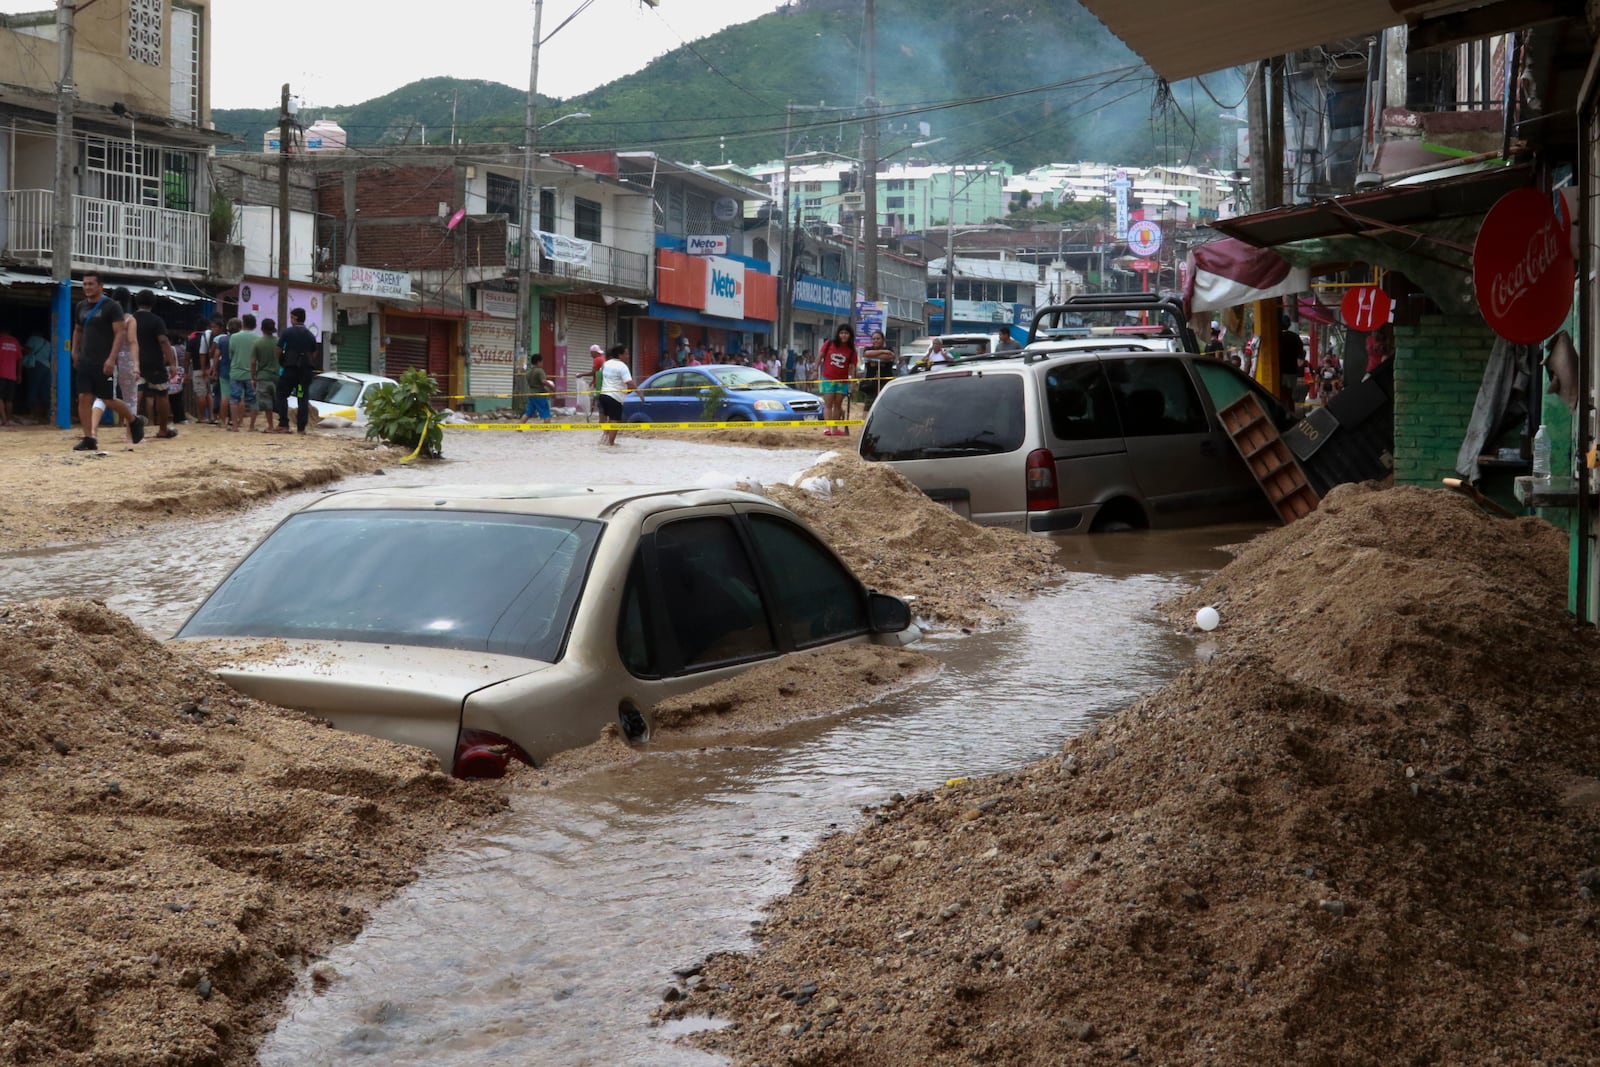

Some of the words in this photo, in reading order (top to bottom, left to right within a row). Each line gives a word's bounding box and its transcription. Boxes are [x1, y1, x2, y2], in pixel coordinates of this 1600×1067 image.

[690, 239, 716, 248] Neto
[711, 269, 735, 299] Neto
[795, 281, 822, 304] FARMACIA
[822, 286, 832, 306] DEL
[832, 288, 850, 309] CENTRO
